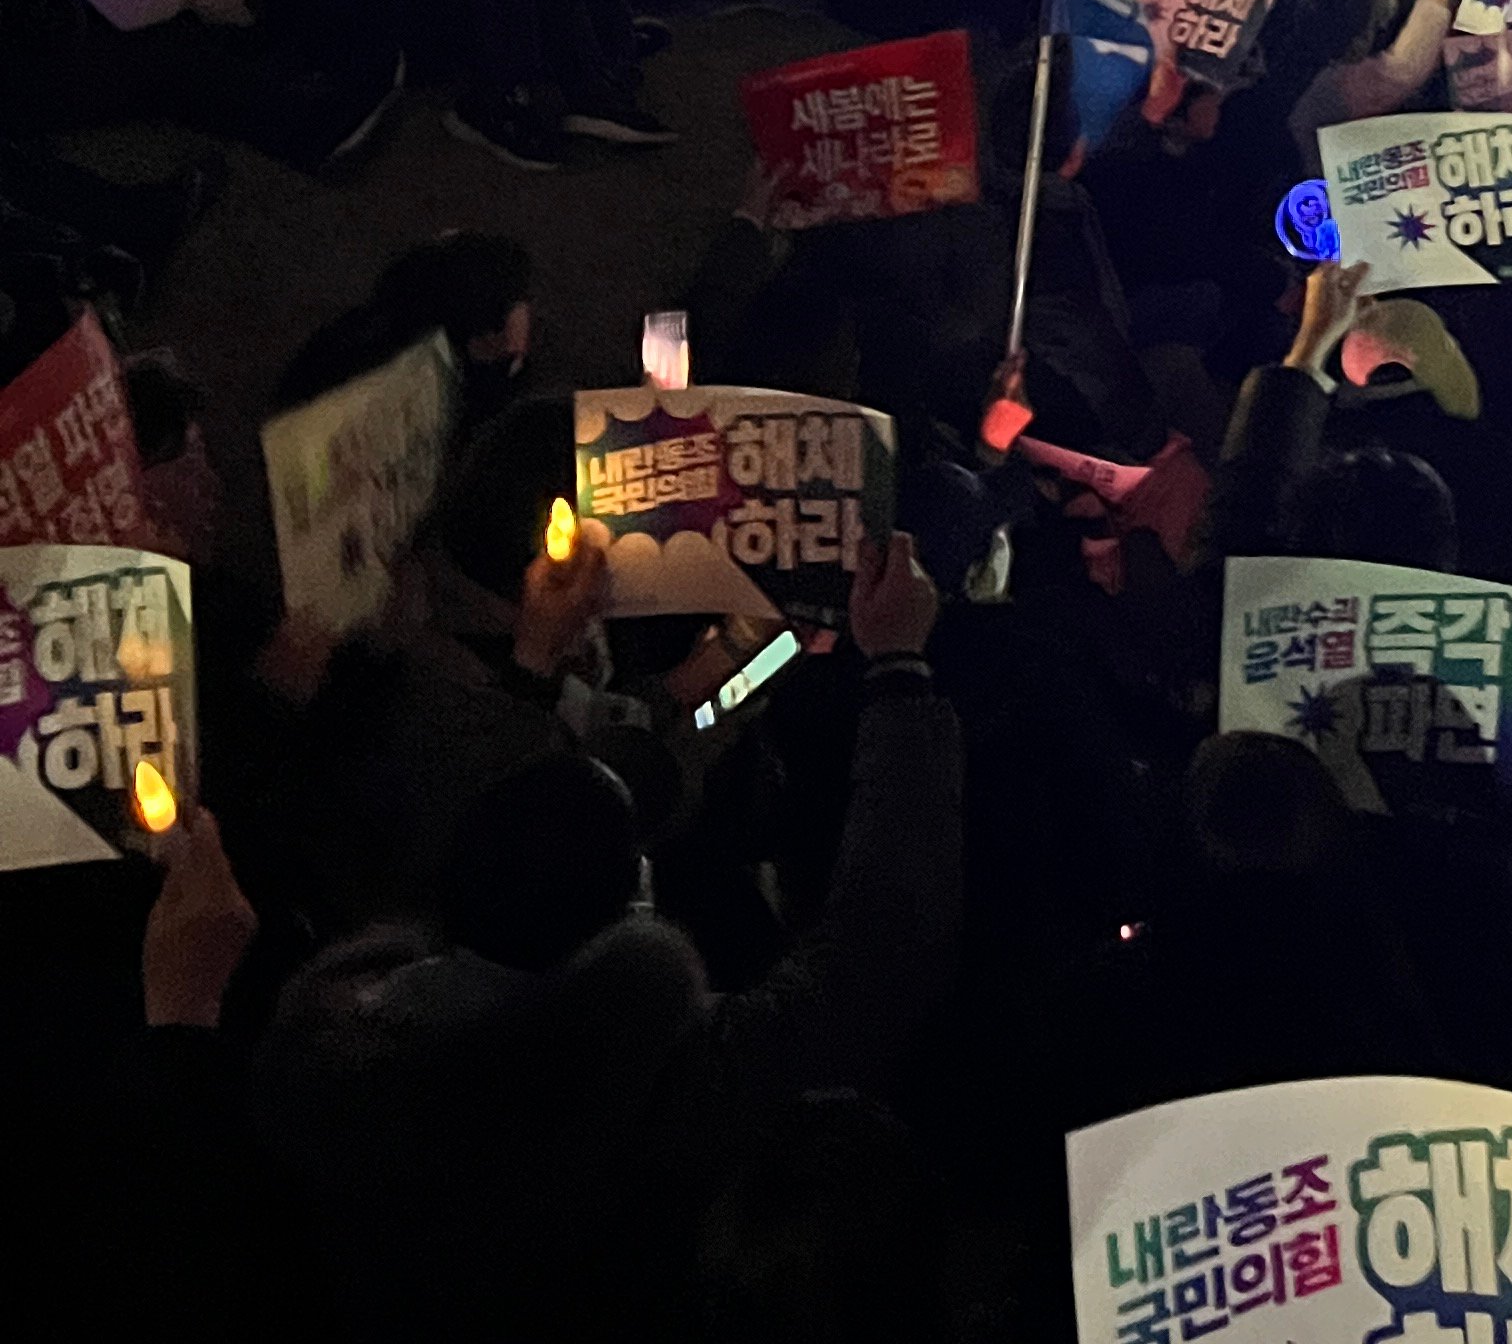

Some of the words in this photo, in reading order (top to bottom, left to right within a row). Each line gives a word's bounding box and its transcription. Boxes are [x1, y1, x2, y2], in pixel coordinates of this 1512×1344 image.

[1168, 8, 1242, 59] 하라
[1336, 139, 1428, 184] 내란동조
[1342, 164, 1430, 206] 국민의힘
[588, 432, 720, 485] 내란동조
[590, 464, 720, 515] 국민의힘
[726, 414, 866, 492] 해체
[726, 496, 868, 572] 하라
[28, 568, 172, 682] 해체
[1243, 596, 1360, 639] 내란수괴
[1368, 592, 1512, 680] 즉각
[1243, 630, 1355, 686] 윤석열
[36, 688, 178, 791] 하라
[1362, 678, 1502, 765] 파면
[1106, 1153, 1340, 1290] 내란동조
[1113, 1224, 1343, 1344] 국민의힘
